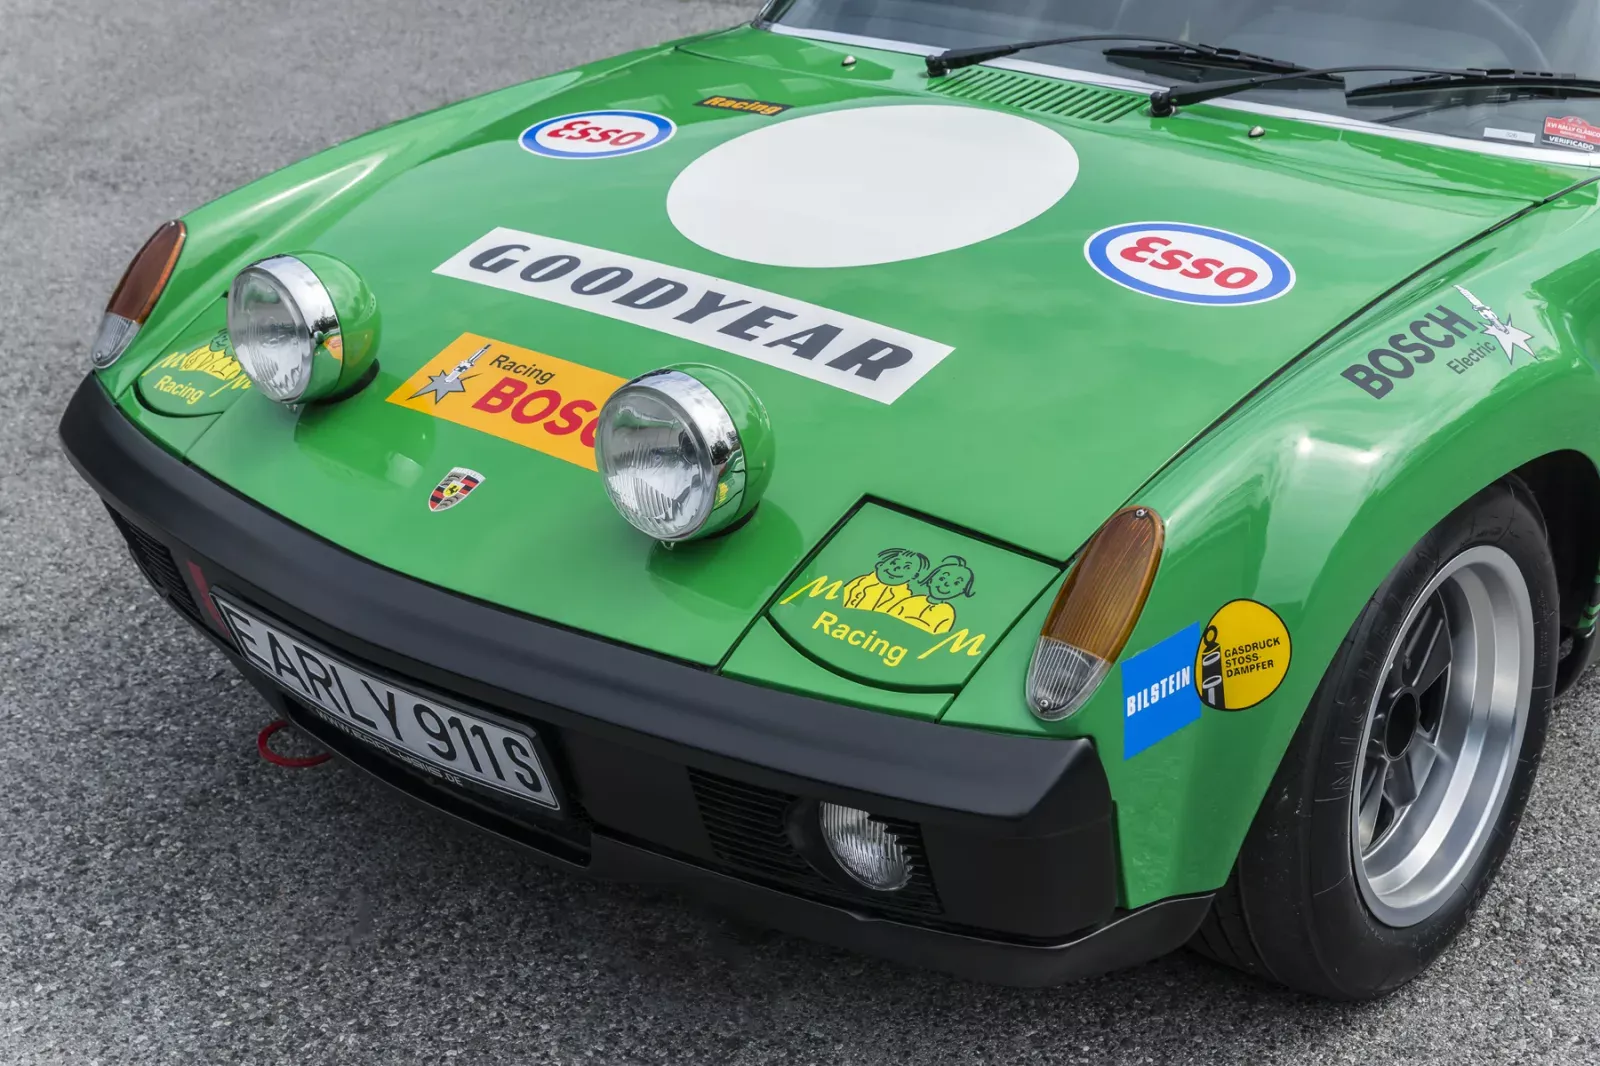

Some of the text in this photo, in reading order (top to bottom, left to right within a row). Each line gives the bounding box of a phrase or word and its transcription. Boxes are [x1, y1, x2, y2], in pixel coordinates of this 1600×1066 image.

[703, 96, 784, 115] Racing
[1549, 136, 1594, 150] VERIFICADO
[469, 243, 914, 382] GOODYEAR
[489, 353, 556, 386] Racing
[1340, 304, 1479, 400] BOSCH
[1446, 339, 1497, 375] Electric
[155, 376, 204, 404] Racing
[811, 610, 909, 668] Racing
[1224, 637, 1281, 659] GASDRUCK
[227, 607, 544, 794] EARLY 911S
[1126, 666, 1191, 717] BILSTEIN
